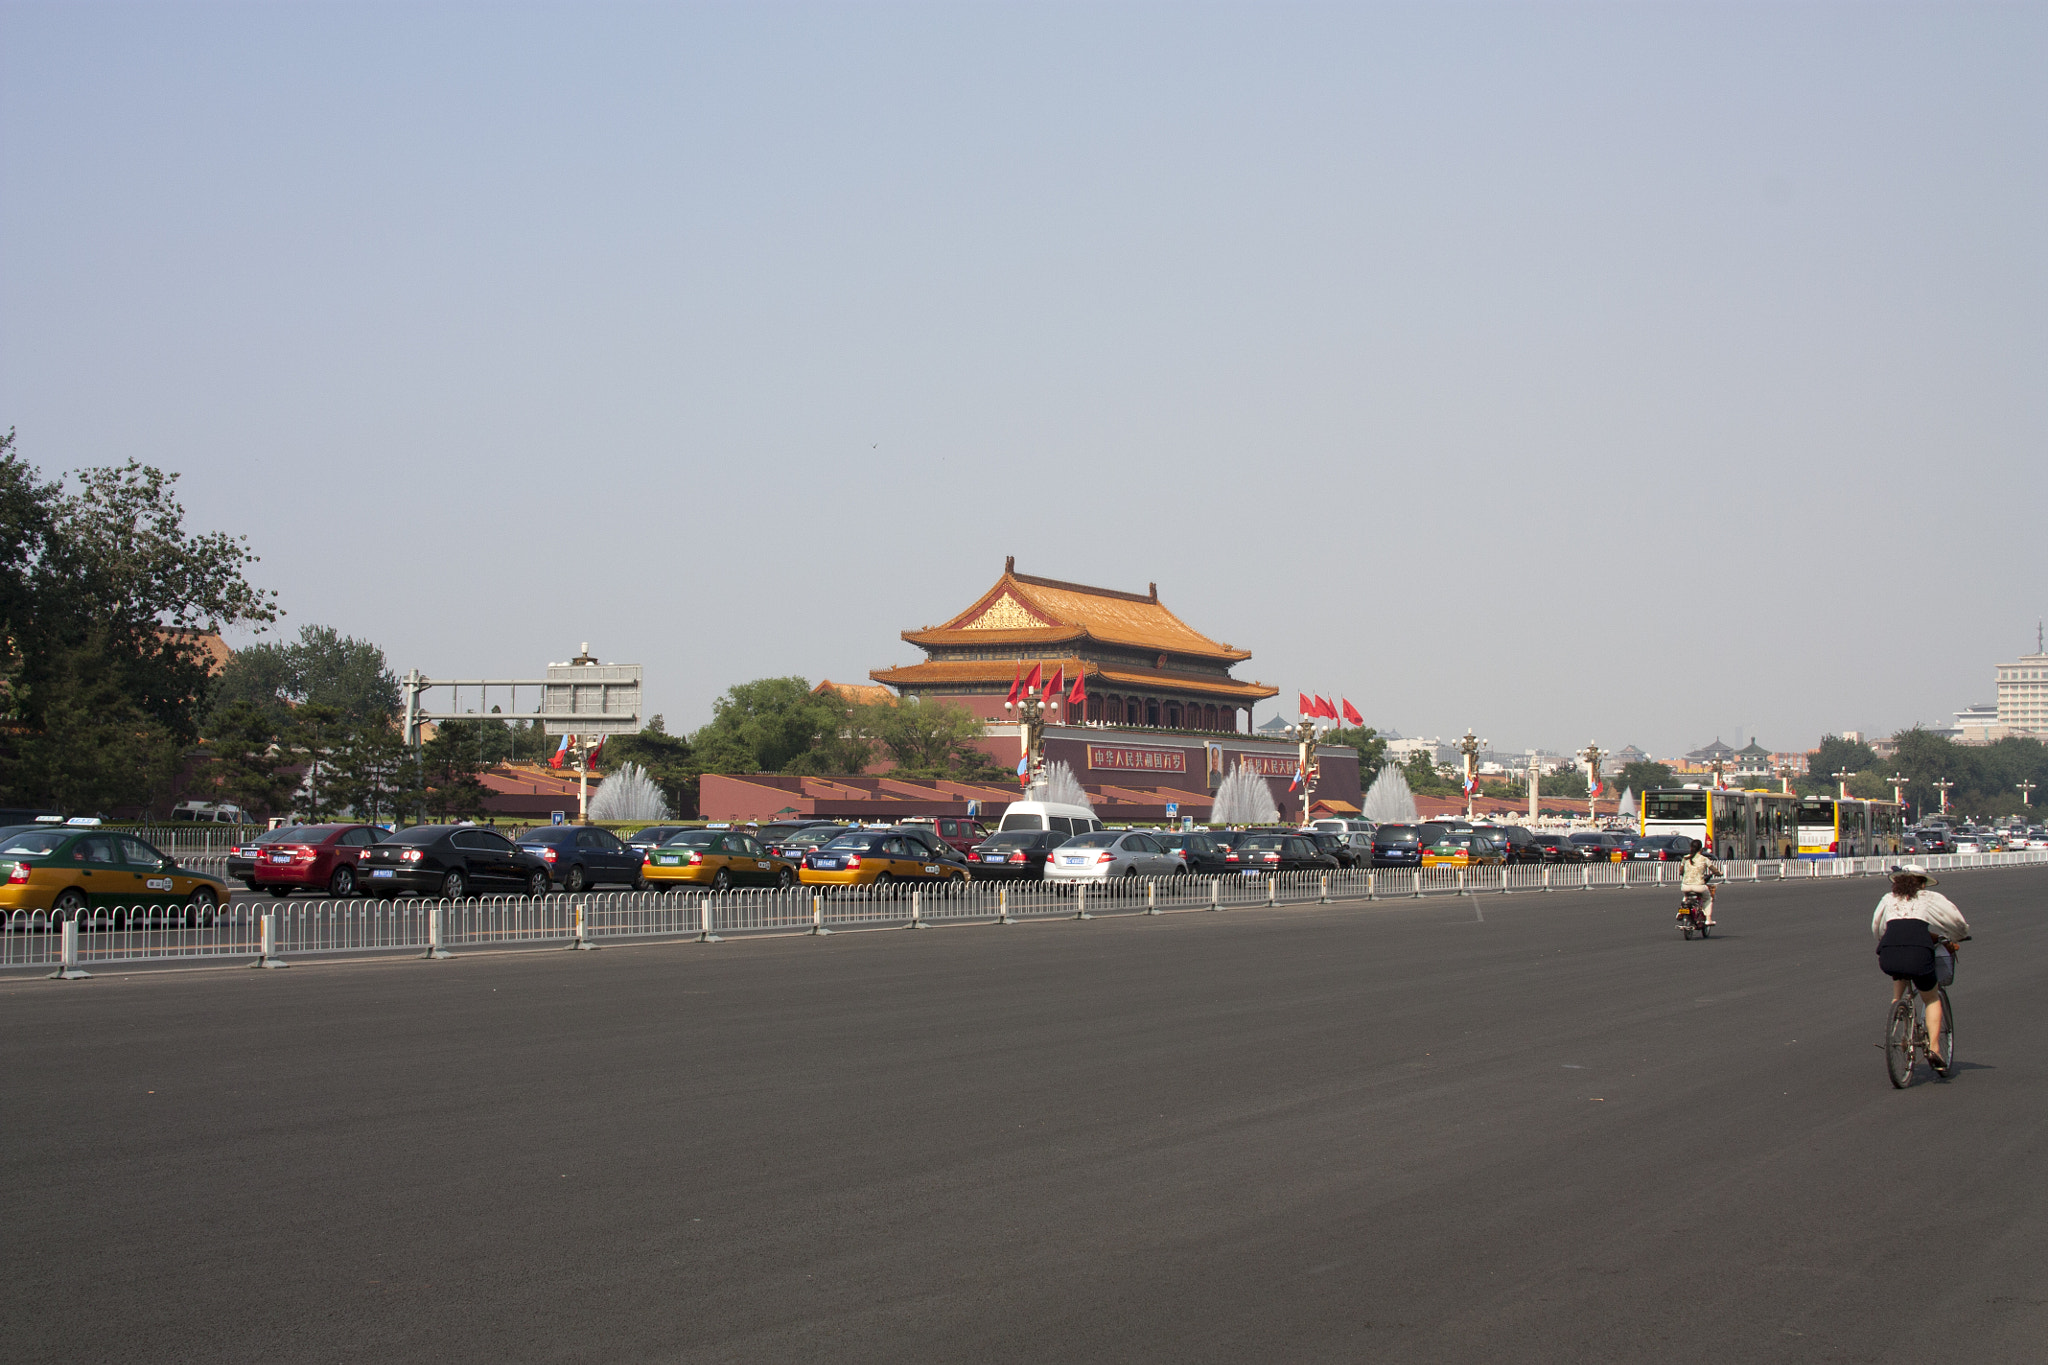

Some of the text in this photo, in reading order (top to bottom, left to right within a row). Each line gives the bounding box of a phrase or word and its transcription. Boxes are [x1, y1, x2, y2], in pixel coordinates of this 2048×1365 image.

[1095, 749, 1181, 769] 中华人民共和国万岁
